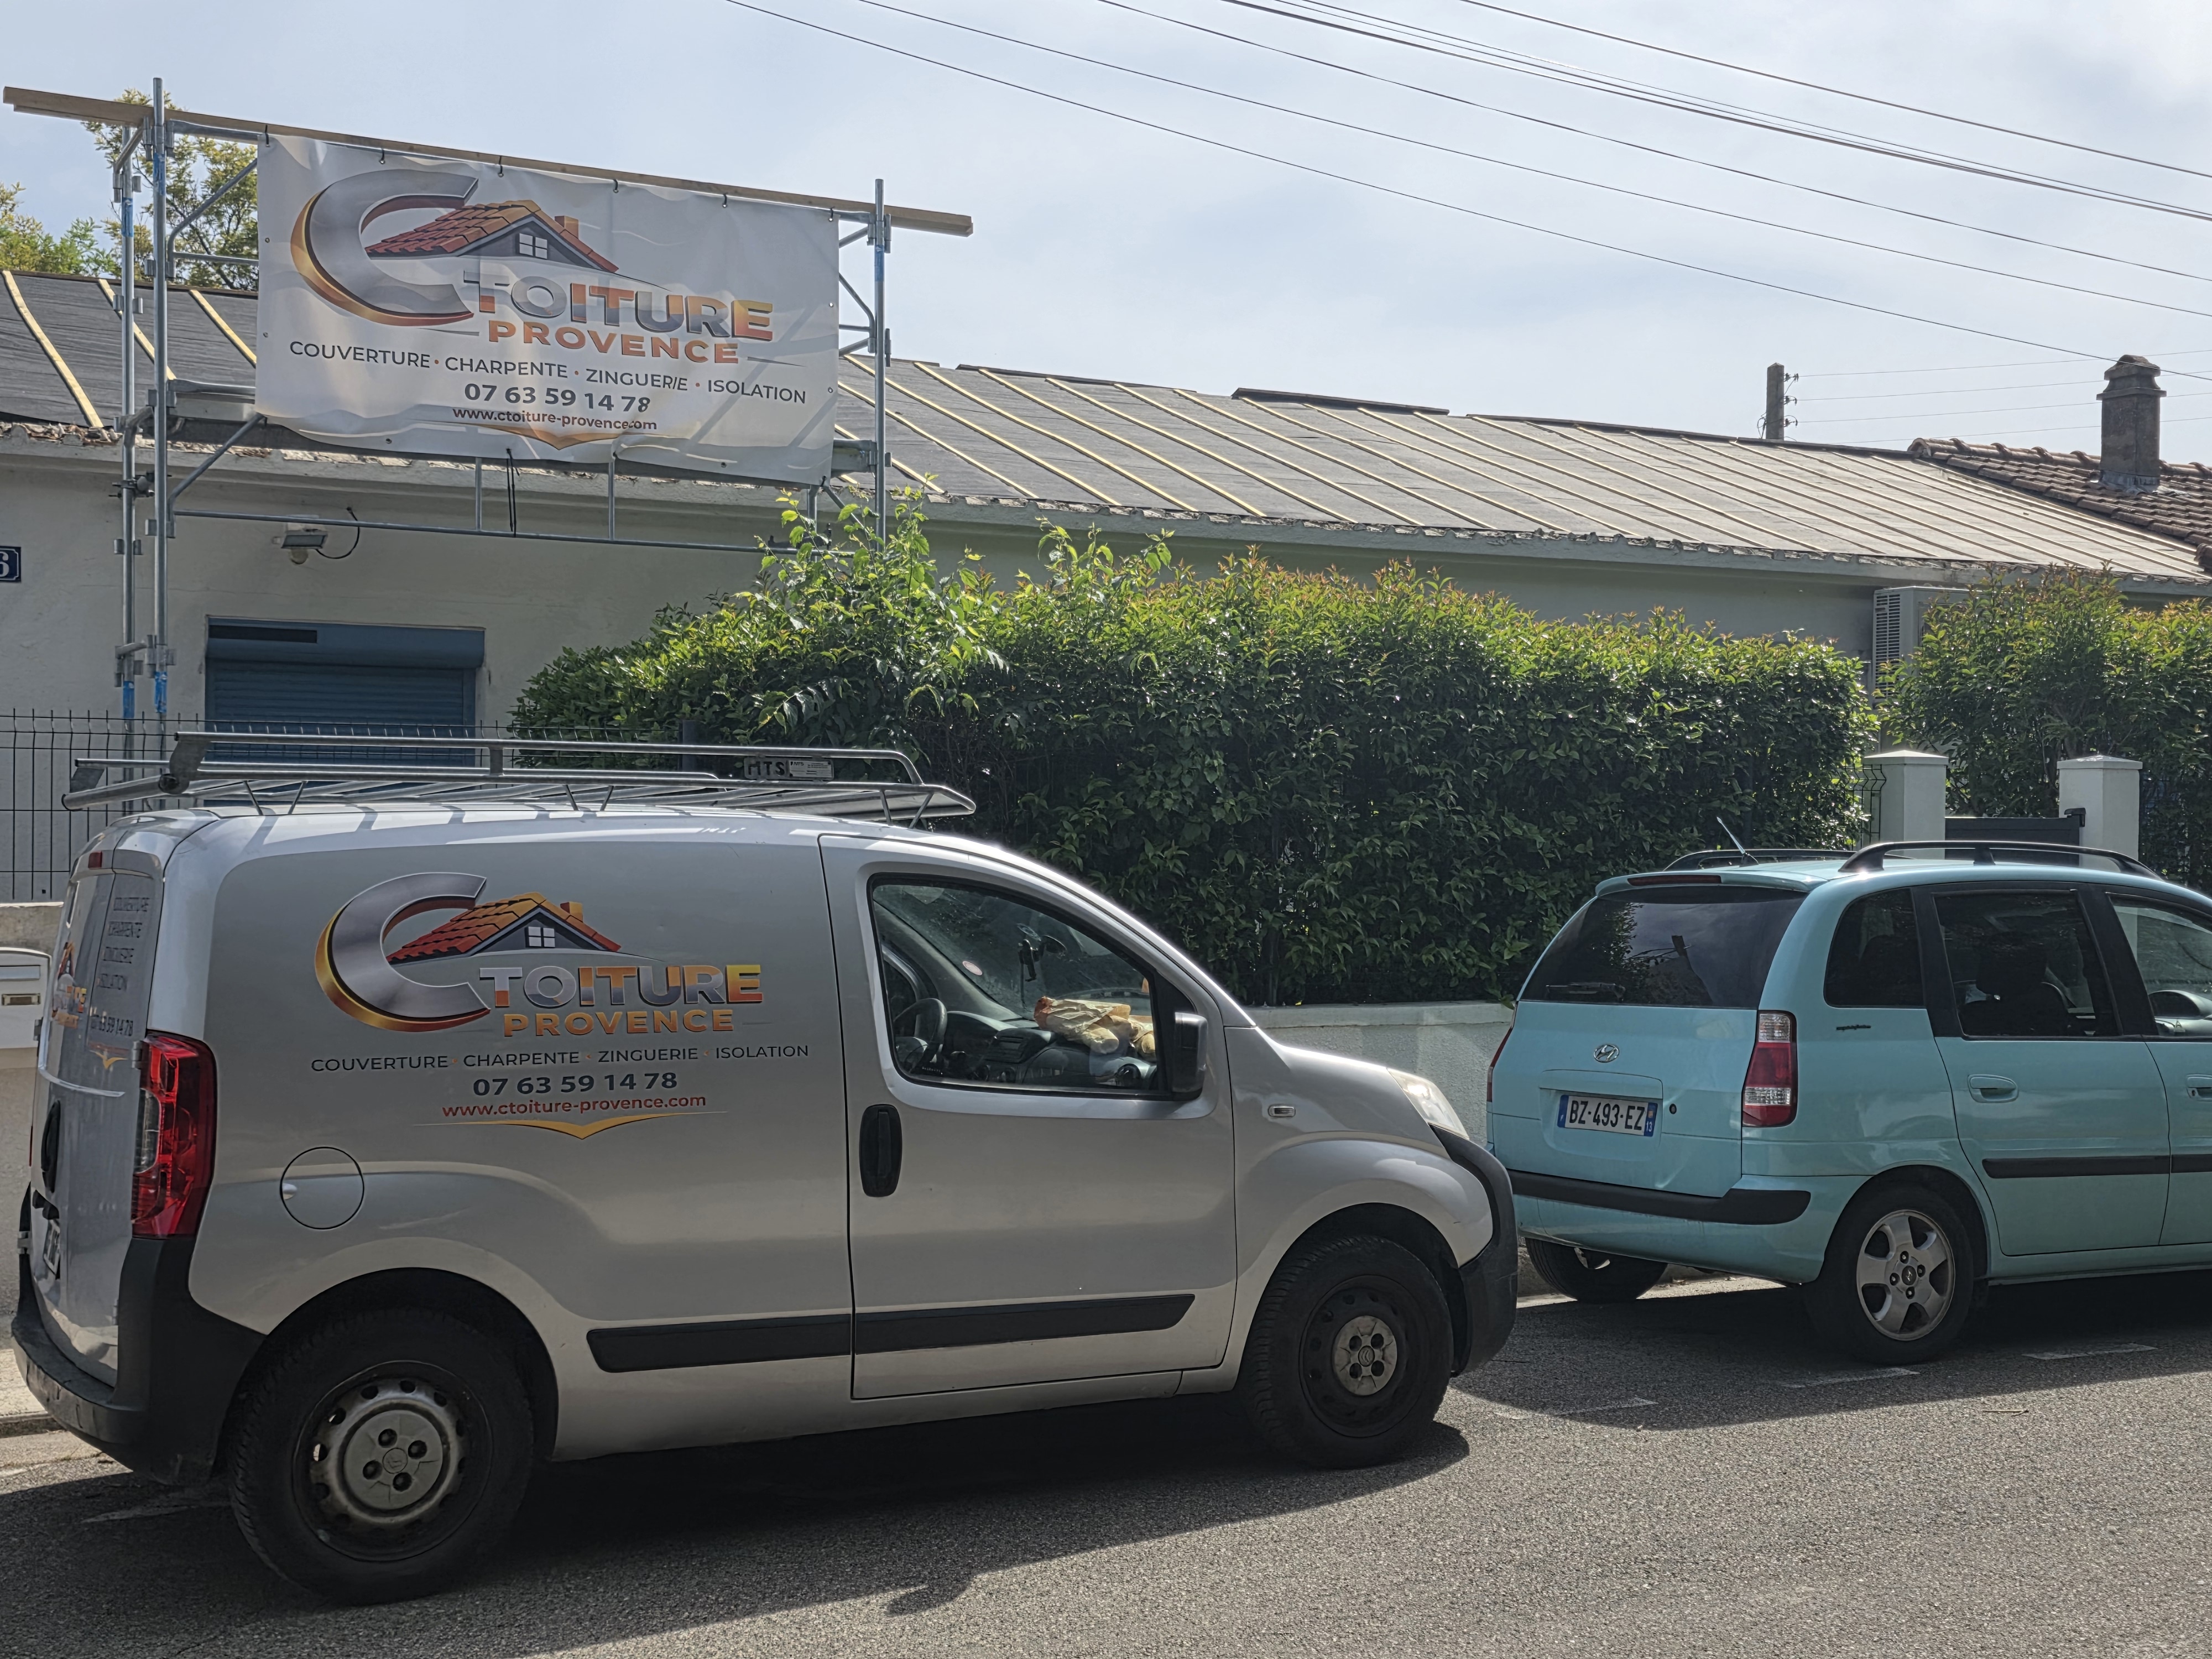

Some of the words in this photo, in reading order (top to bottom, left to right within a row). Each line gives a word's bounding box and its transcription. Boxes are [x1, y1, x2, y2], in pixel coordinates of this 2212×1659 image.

[463, 270, 773, 342] TOITURE
[489, 320, 739, 363] PROVENCE
[290, 341, 430, 368] COUVERTURE
[445, 357, 568, 378] CHARPENTE
[586, 368, 687, 392] ZINGUERIE
[708, 379, 806, 404] ISOLATION
[465, 383, 497, 402] 07
[505, 386, 536, 404] 63
[545, 388, 576, 406] 59
[585, 393, 614, 411] 14
[622, 396, 651, 413] 78
[452, 408, 657, 430] www.ctoiture-provencecom
[479, 964, 763, 1008] TOITURE
[504, 1010, 734, 1037] PROVENCE
[311, 1055, 448, 1072] COUVERTURE
[463, 1051, 580, 1067] CHARPENTE
[598, 1048, 698, 1063] ZINGUERIE
[716, 1045, 808, 1059] ISOLATION
[473, 1078, 508, 1096] 07
[517, 1076, 551, 1094] 63
[561, 1074, 594, 1093] 59
[604, 1073, 637, 1091] 14
[644, 1072, 677, 1089] 78
[442, 1095, 706, 1118] www.ctoiture-provence.com
[1569, 1100, 1645, 1131] BZ-493-EZ
[1646, 1120, 1652, 1133] 13
